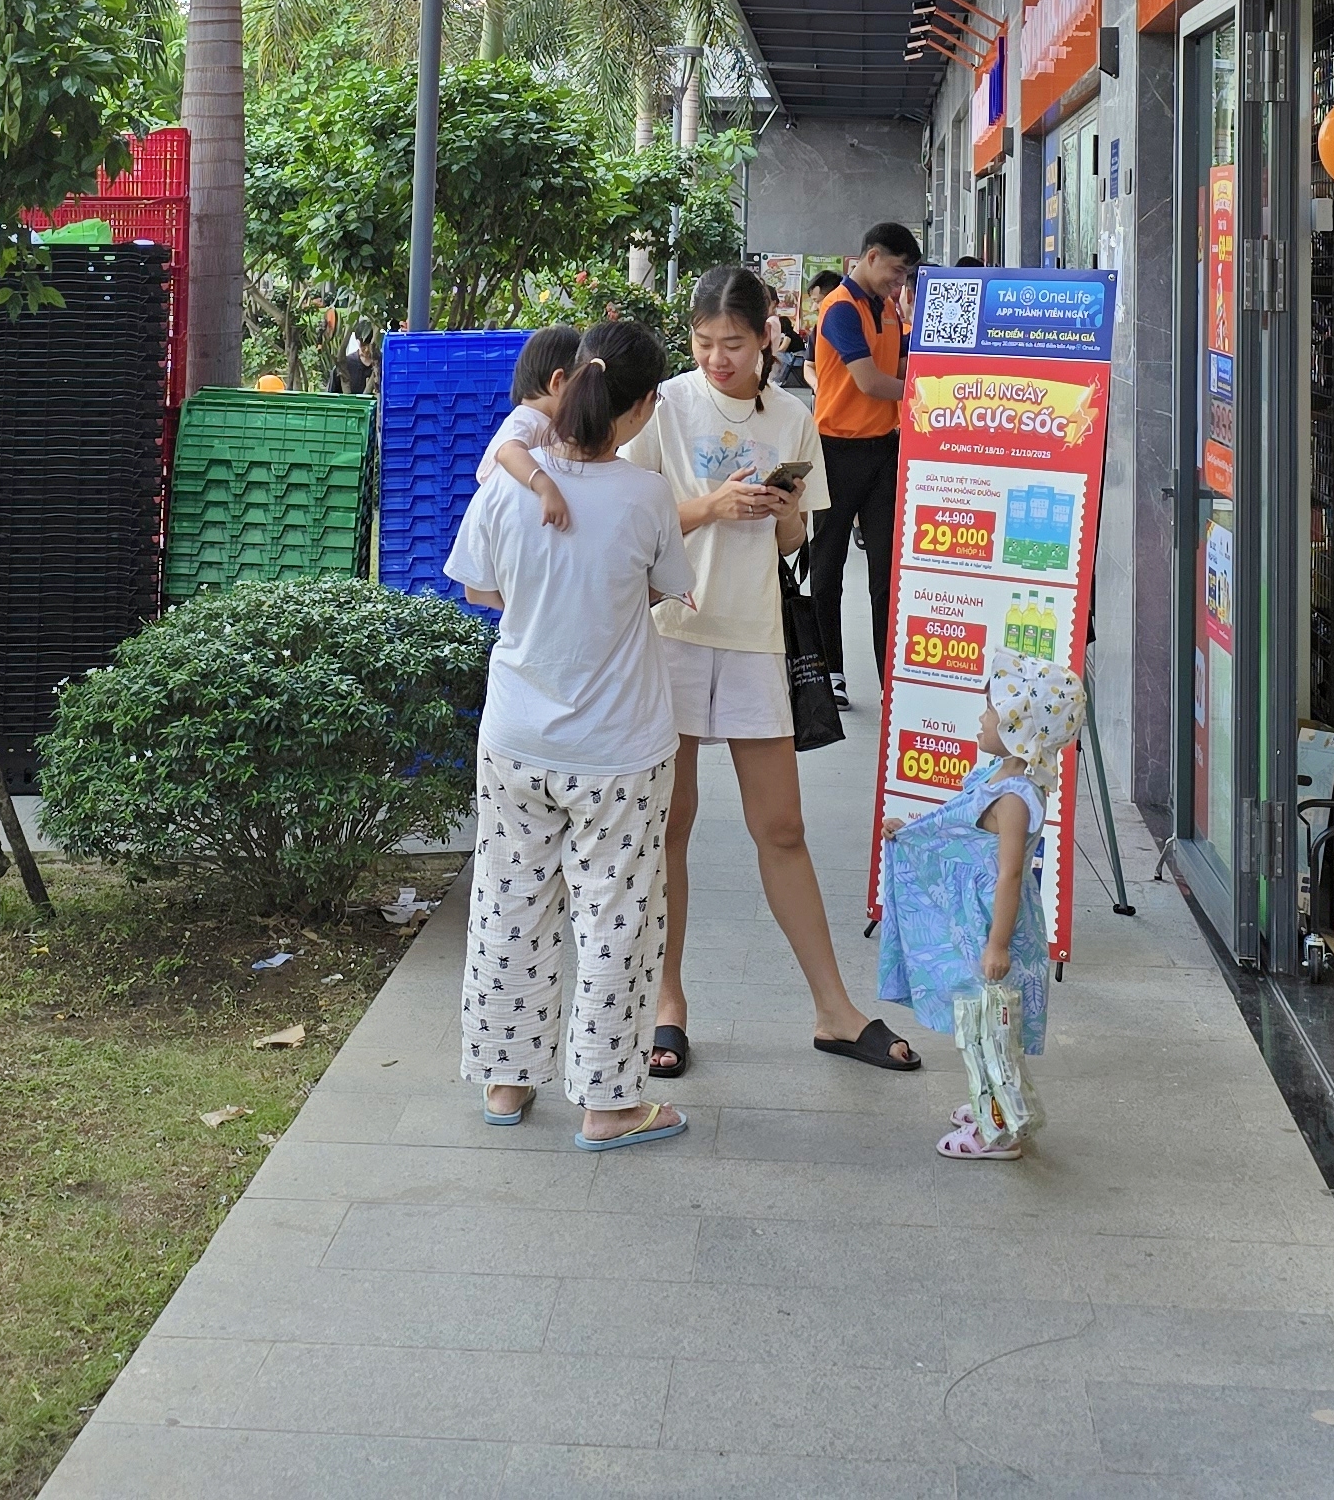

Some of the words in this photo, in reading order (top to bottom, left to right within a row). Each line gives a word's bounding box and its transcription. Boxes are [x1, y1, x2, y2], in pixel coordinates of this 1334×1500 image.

[997, 287, 1017, 302] TẢI
[1038, 289, 1091, 304] OneLife
[996, 307, 1013, 317] APP
[1014, 306, 1043, 318] THÀNH
[1044, 308, 1064, 318] VIÊN
[1065, 309, 1089, 319] NGAY
[987, 328, 1004, 338] TÍCH
[1005, 328, 1024, 339] ĐIỂM
[1045, 330, 1058, 340] MÃ
[1058, 331, 1080, 341] GIẢM
[1080, 331, 1095, 342] GIÁ
[953, 379, 984, 400] CHỈ
[985, 382, 996, 398] 4
[999, 383, 1048, 403] NGÀY
[929, 403, 966, 428] GIÁ
[970, 405, 1016, 433] CỰC
[1020, 407, 1068, 437] SỐC
[939, 441, 950, 451] ÁP
[951, 444, 972, 454] DỤNG
[972, 443, 984, 453] TỪ
[984, 446, 1005, 455] 18/10
[915, 483, 935, 492] GREEN
[935, 485, 953, 494] FARM
[953, 485, 976, 496] KHÔNG
[935, 510, 975, 526] 44.900
[919, 523, 988, 552] 29.000
[955, 546, 978, 558] Đ/HỘP
[934, 592, 956, 605] ĐẬU
[956, 593, 984, 607] NÀNH
[925, 621, 966, 639] 65.000
[910, 634, 979, 664] 39.000
[946, 659, 969, 670] Đ/CHAI
[921, 718, 940, 731] TÁO
[941, 721, 956, 734] TÚI
[913, 735, 961, 755] 119.000
[903, 749, 971, 780] 69.000
[932, 775, 950, 785] Đ/TÚI
